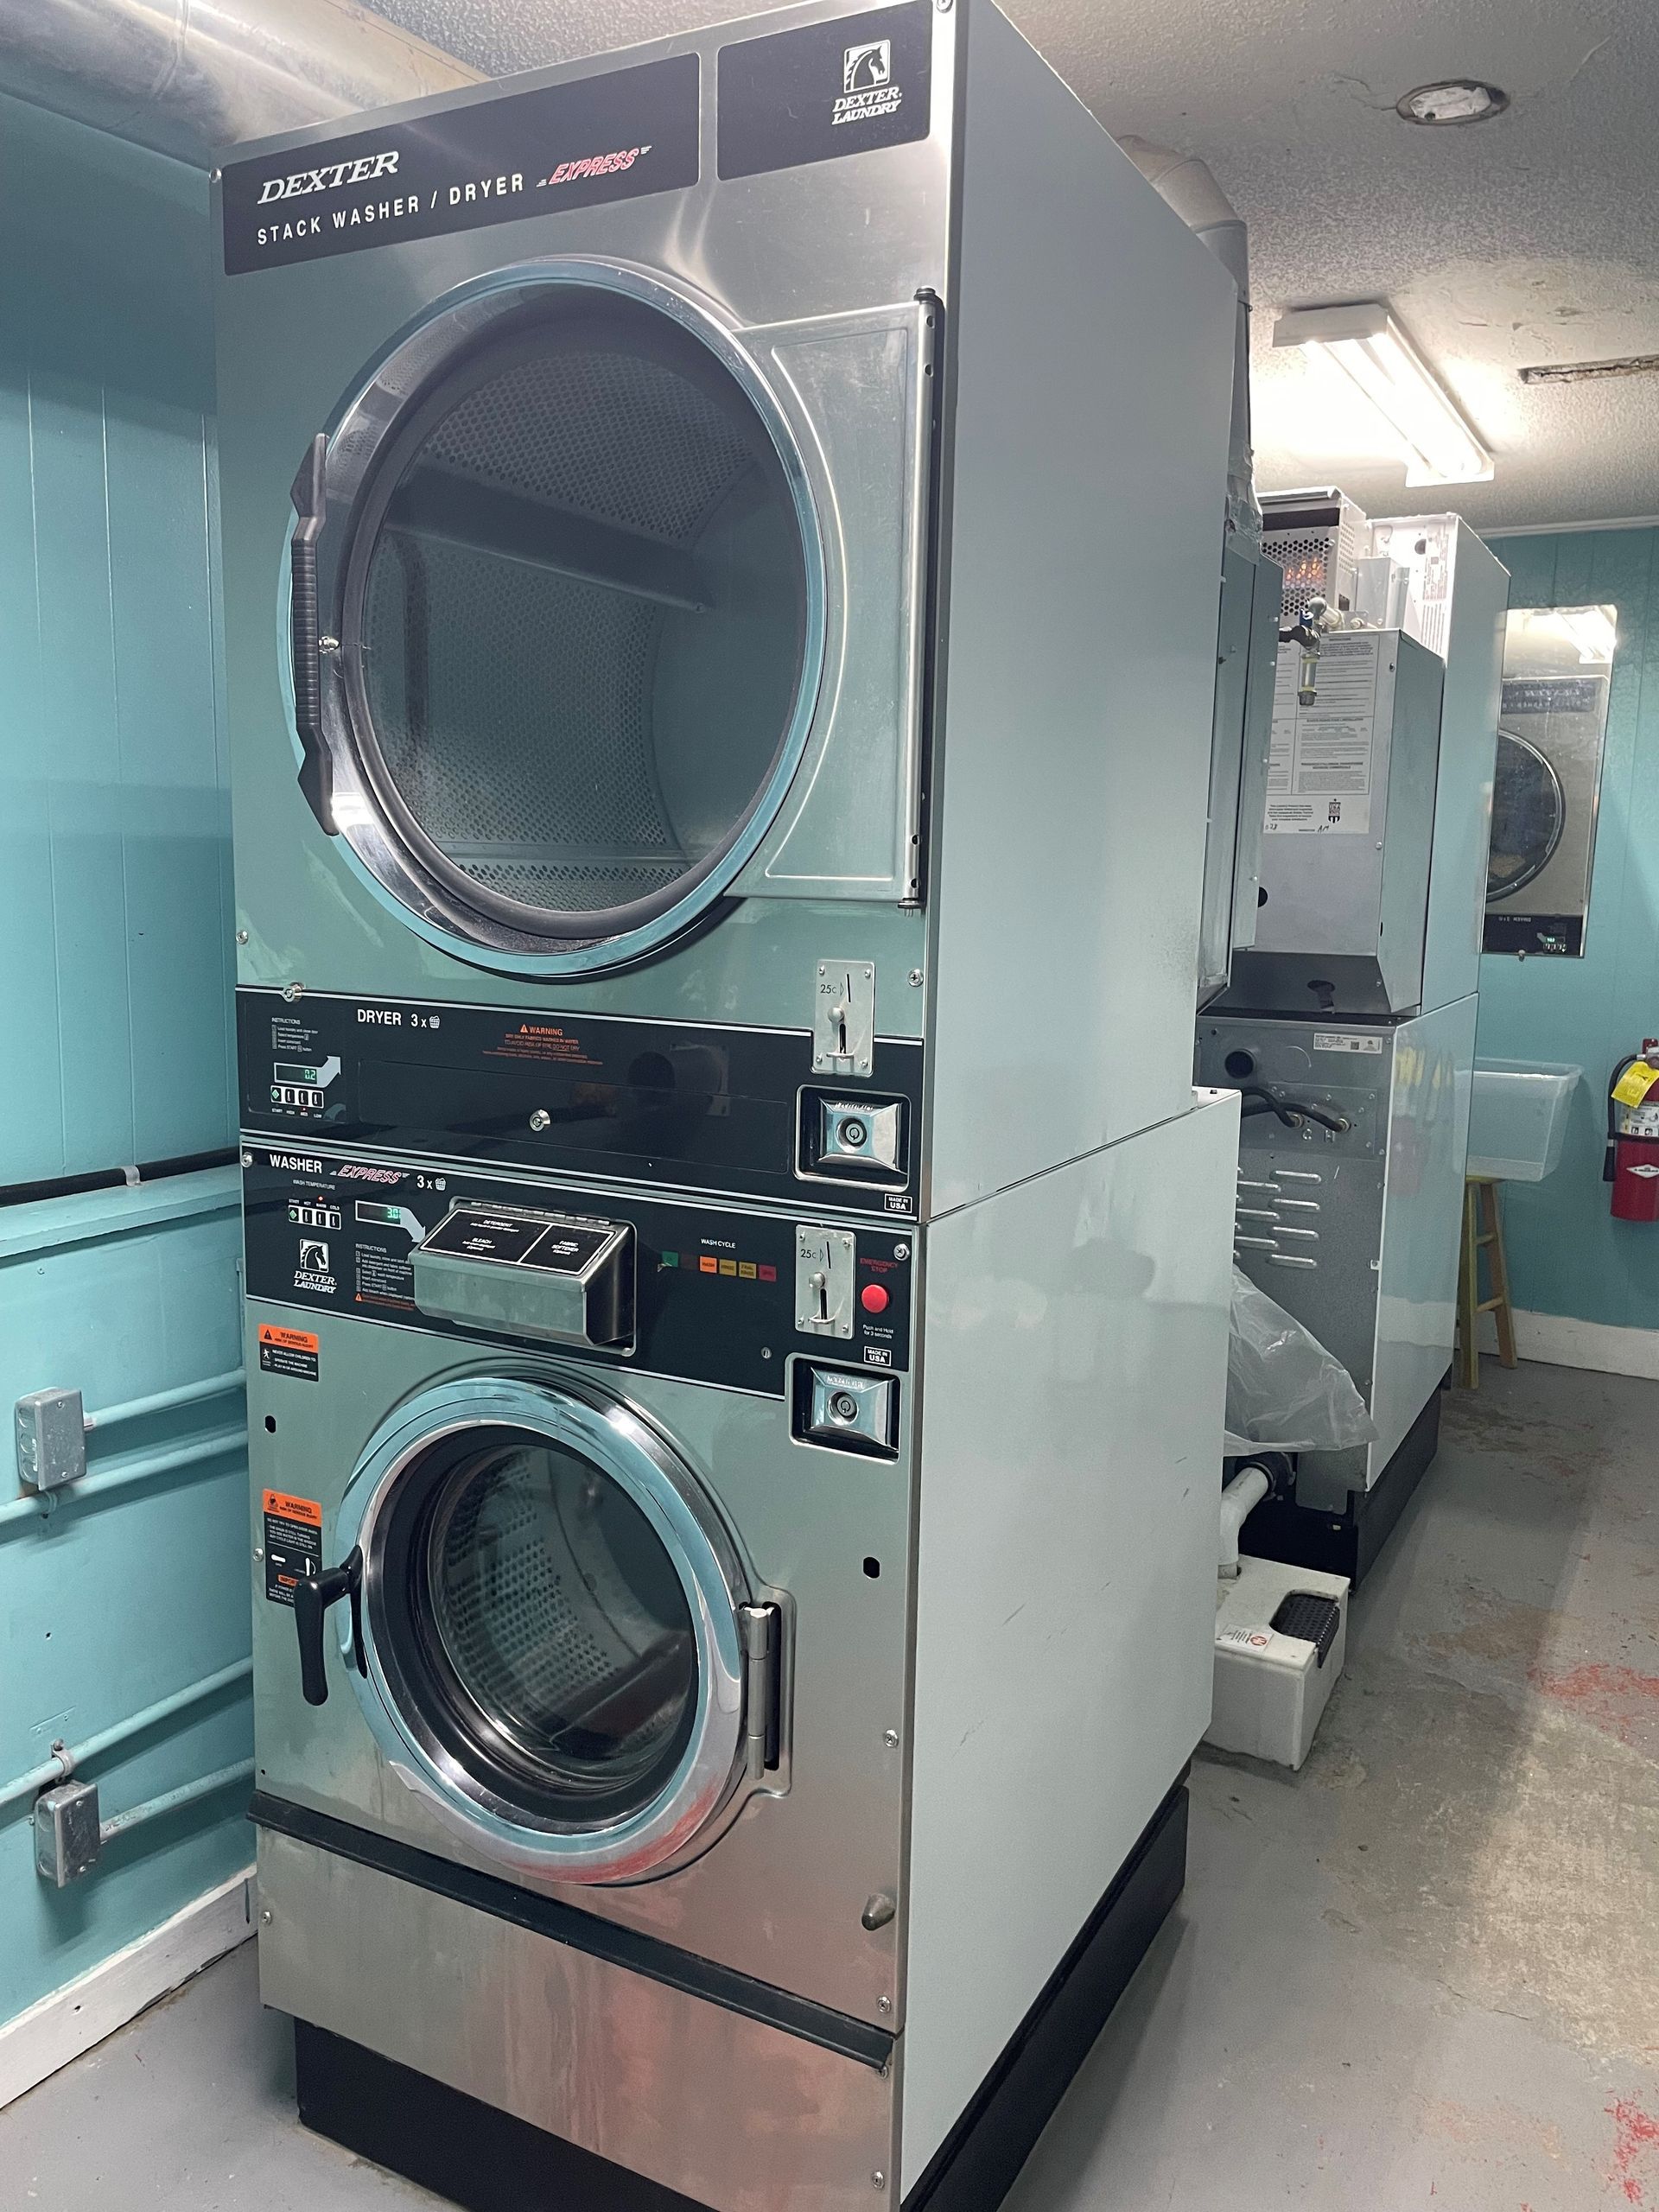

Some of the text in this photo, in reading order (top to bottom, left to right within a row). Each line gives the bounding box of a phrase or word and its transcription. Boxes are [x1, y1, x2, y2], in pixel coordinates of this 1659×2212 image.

[831, 99, 902, 125] LAUNDRY
[257, 150, 399, 205] DEXTER
[257, 147, 641, 245] STACK WASHER / DRYER EXPRESS
[357, 1008, 402, 1027] DRYER
[410, 1013, 418, 1027] 3
[529, 1026, 563, 1037] WARNING
[269, 1154, 322, 1174] WASHER
[336, 1165, 404, 1185] EXPRESS
[416, 1174, 425, 1189] 3
[305, 1181, 336, 1191] TEMPERATURE
[889, 1202, 906, 1211] USA
[482, 1219, 514, 1228] DETERGENT
[355, 1243, 387, 1254] INSTRUCTIONS
[700, 1238, 736, 1249] WASH CYCLE
[860, 1257, 898, 1268] EMERGENCY
[293, 1280, 338, 1294] LAUNDRY
[279, 1332, 308, 1344] WARNING
[868, 1355, 886, 1363] USA
[285, 1502, 313, 1515] WARNING
